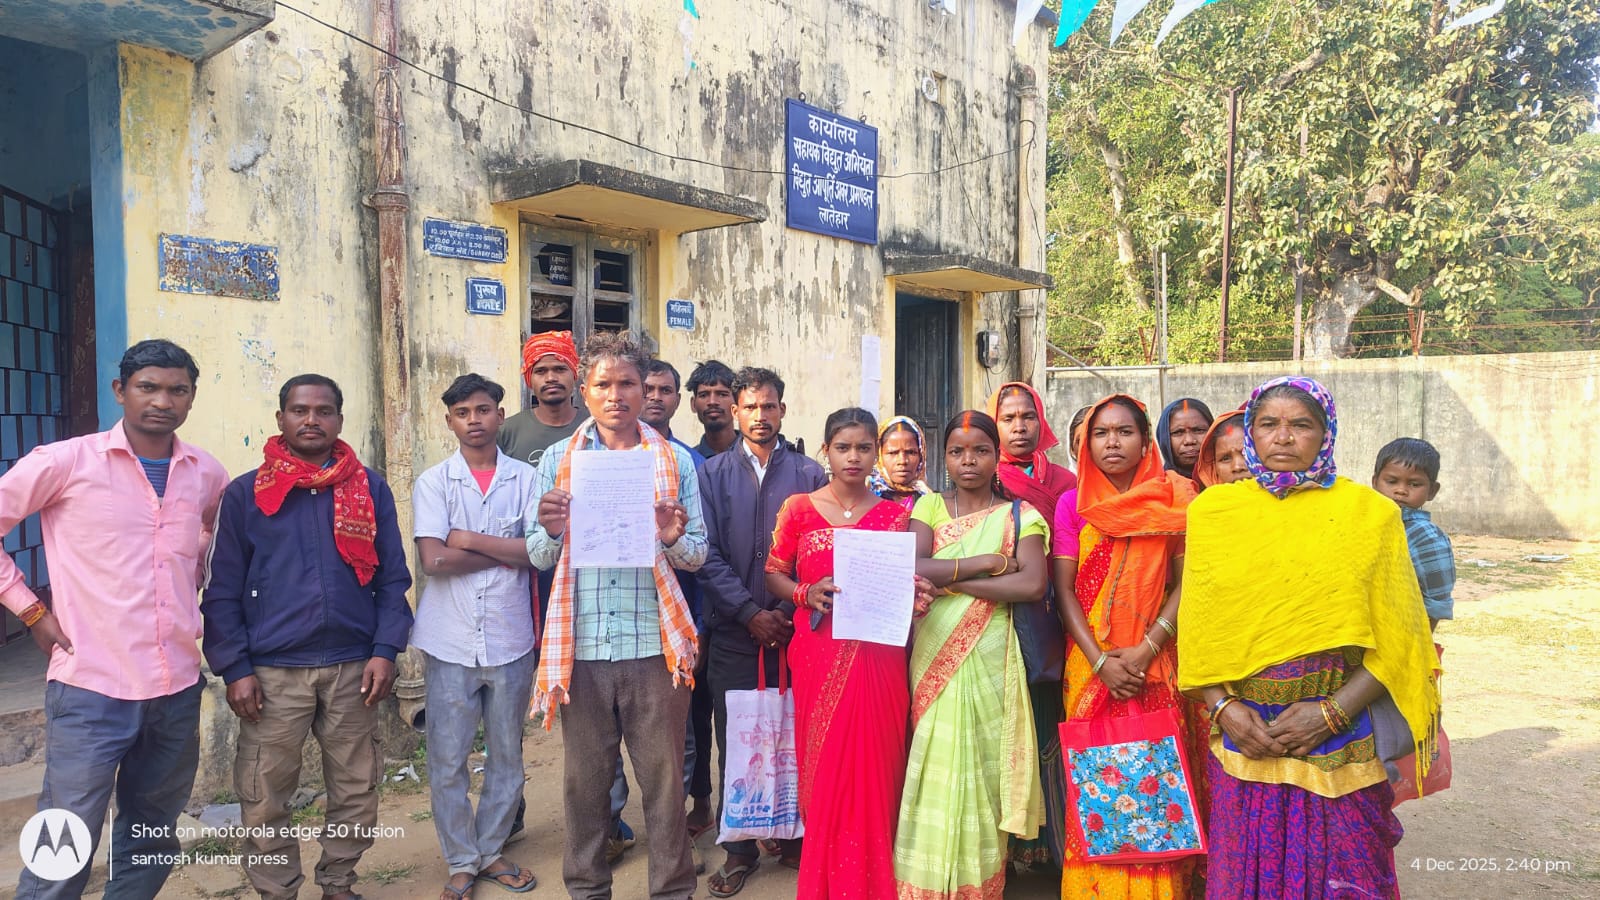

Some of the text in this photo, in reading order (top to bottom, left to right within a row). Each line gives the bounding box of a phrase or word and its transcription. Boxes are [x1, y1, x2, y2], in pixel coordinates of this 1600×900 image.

[808, 114, 858, 145] कार्यालय
[793, 137, 820, 163] सहायक
[821, 140, 844, 173] विद्युत
[791, 163, 811, 198] विद्युत
[811, 173, 836, 204] आपूर्ति
[848, 183, 874, 209] प्रमण्डल
[818, 204, 850, 230] लातेहार
[476, 299, 501, 311] MALE
[670, 317, 692, 327] FEMALE
